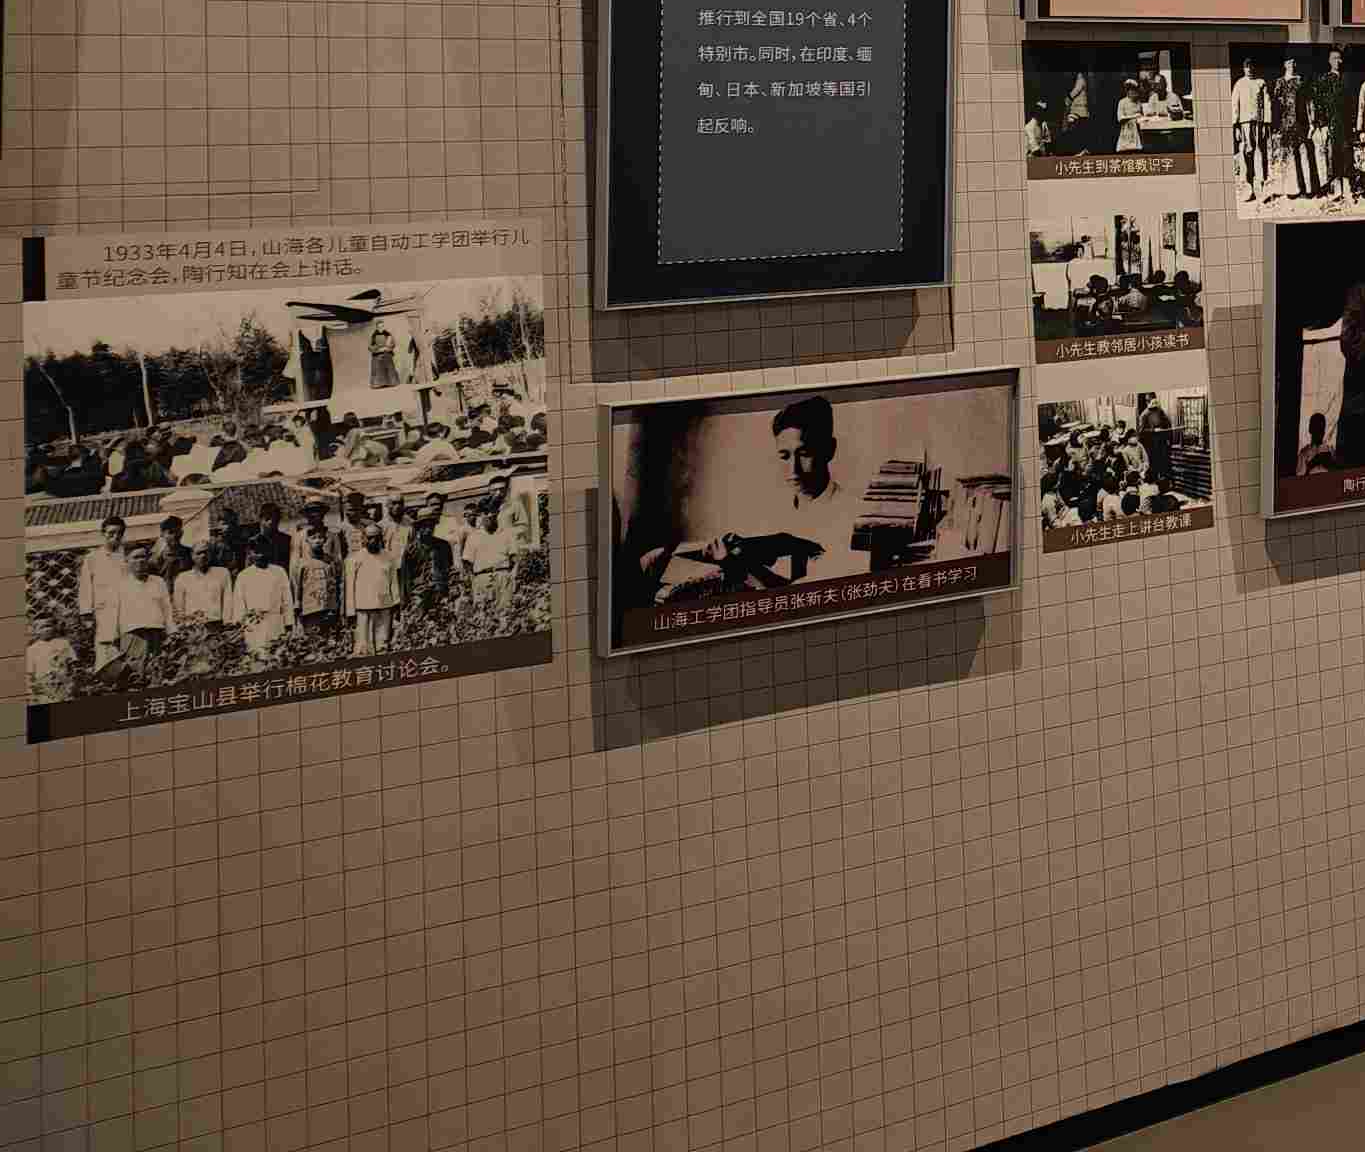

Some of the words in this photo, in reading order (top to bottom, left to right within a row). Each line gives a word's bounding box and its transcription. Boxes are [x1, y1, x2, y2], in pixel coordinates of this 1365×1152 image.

[696, 115, 755, 136] 起反响。
[103, 227, 530, 263] 1933年4月4日，山海各儿童自动工学团举行儿
[55, 256, 362, 290] 童节纪念会，陶行知在会上讲话。
[118, 656, 451, 723] 上海宝山县举行棉花教育讨论会。
